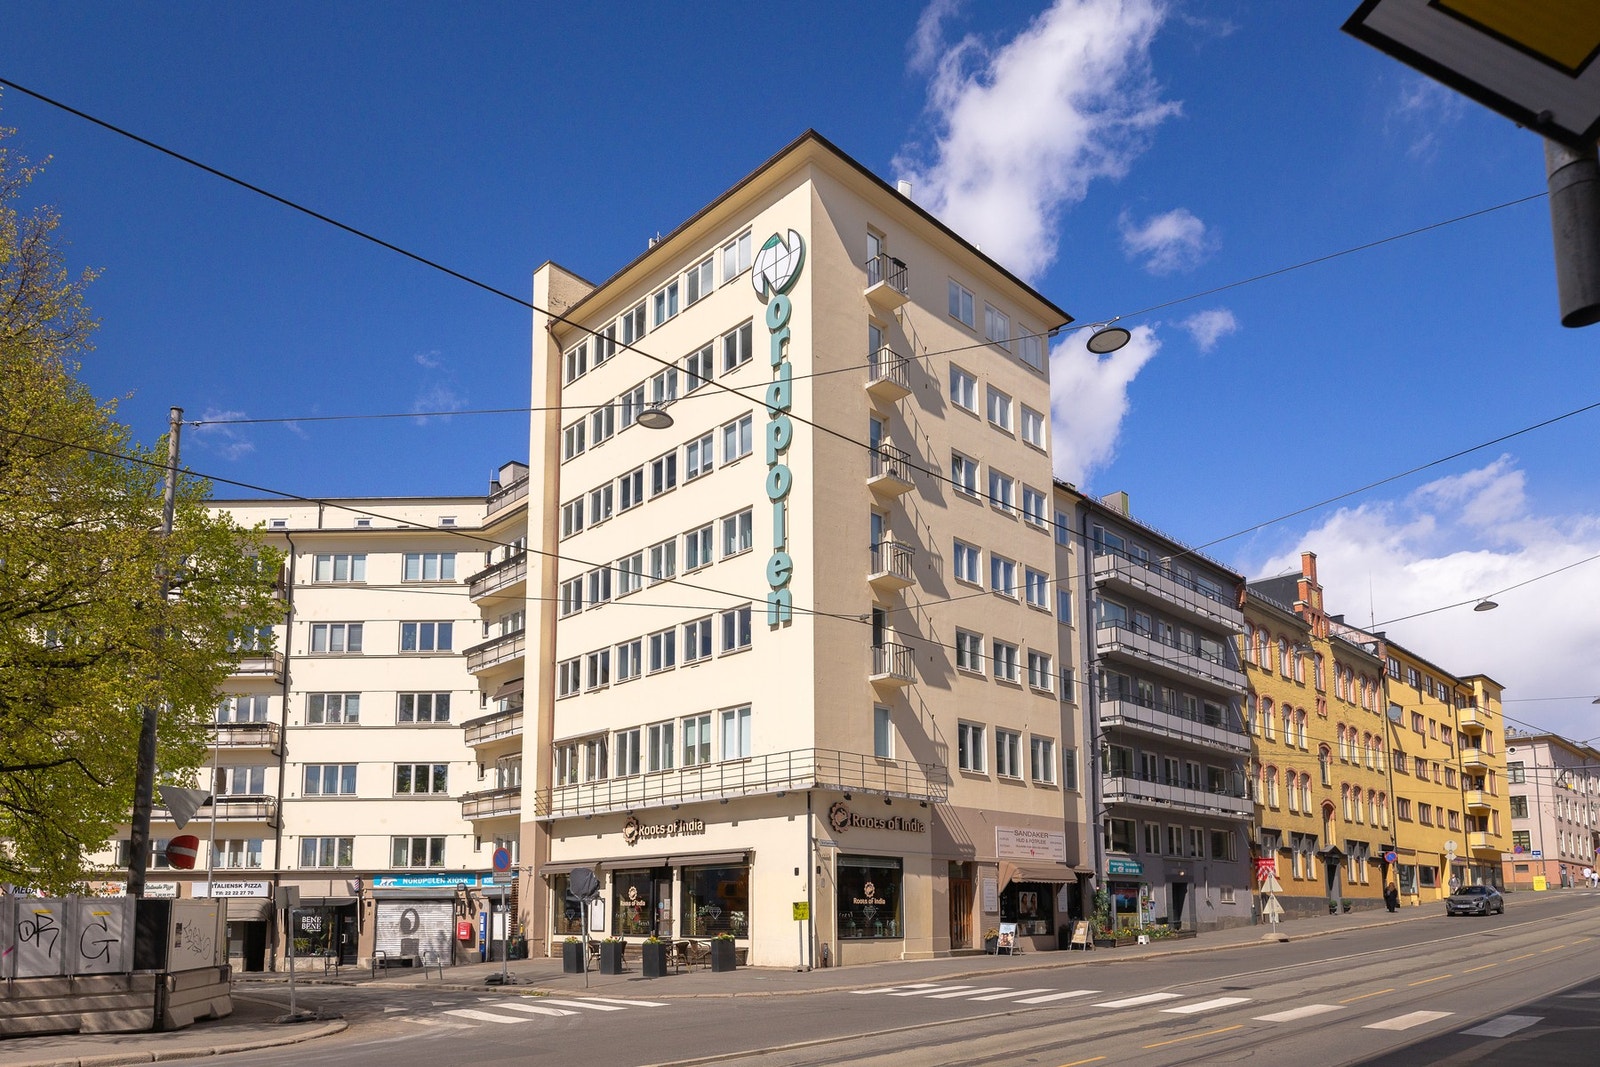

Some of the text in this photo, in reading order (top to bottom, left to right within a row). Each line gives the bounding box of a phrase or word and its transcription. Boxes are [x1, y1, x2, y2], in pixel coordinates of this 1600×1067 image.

[851, 813, 926, 833] Roots of India
[639, 820, 703, 836] Roots of India
[1014, 830, 1049, 839] SANDAKER
[402, 877, 446, 885] NORDPOLEN
[12, 886, 38, 894] MEGA
[301, 915, 321, 923] BENE
